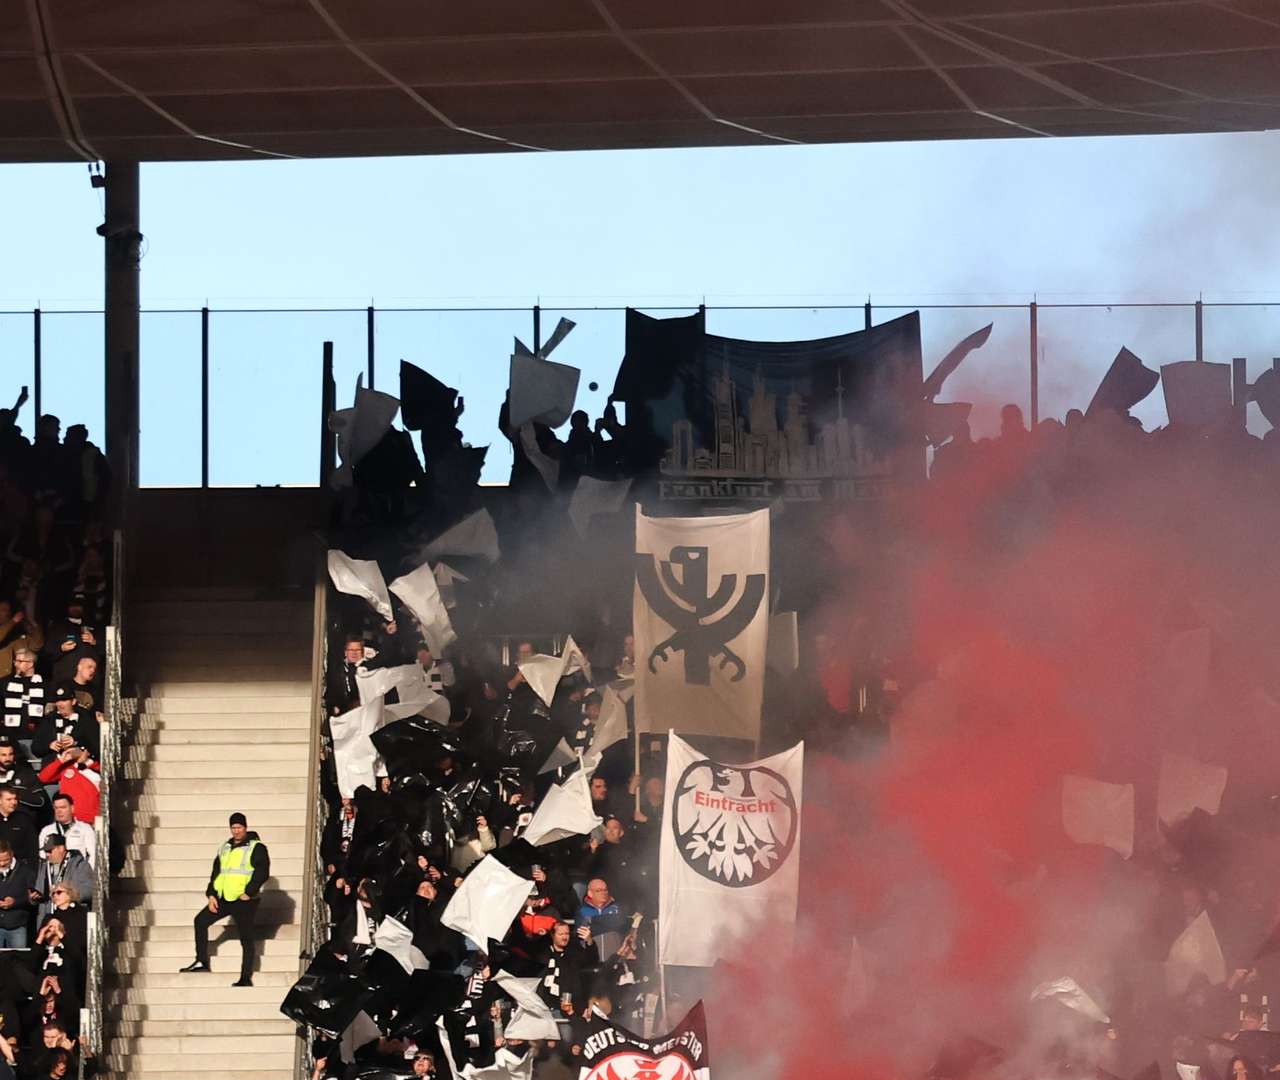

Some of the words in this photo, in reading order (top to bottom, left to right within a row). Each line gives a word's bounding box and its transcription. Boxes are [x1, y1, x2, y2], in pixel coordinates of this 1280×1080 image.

[659, 478, 773, 499] Frankfurt
[785, 479, 822, 499] am
[695, 791, 776, 813] Eintracht
